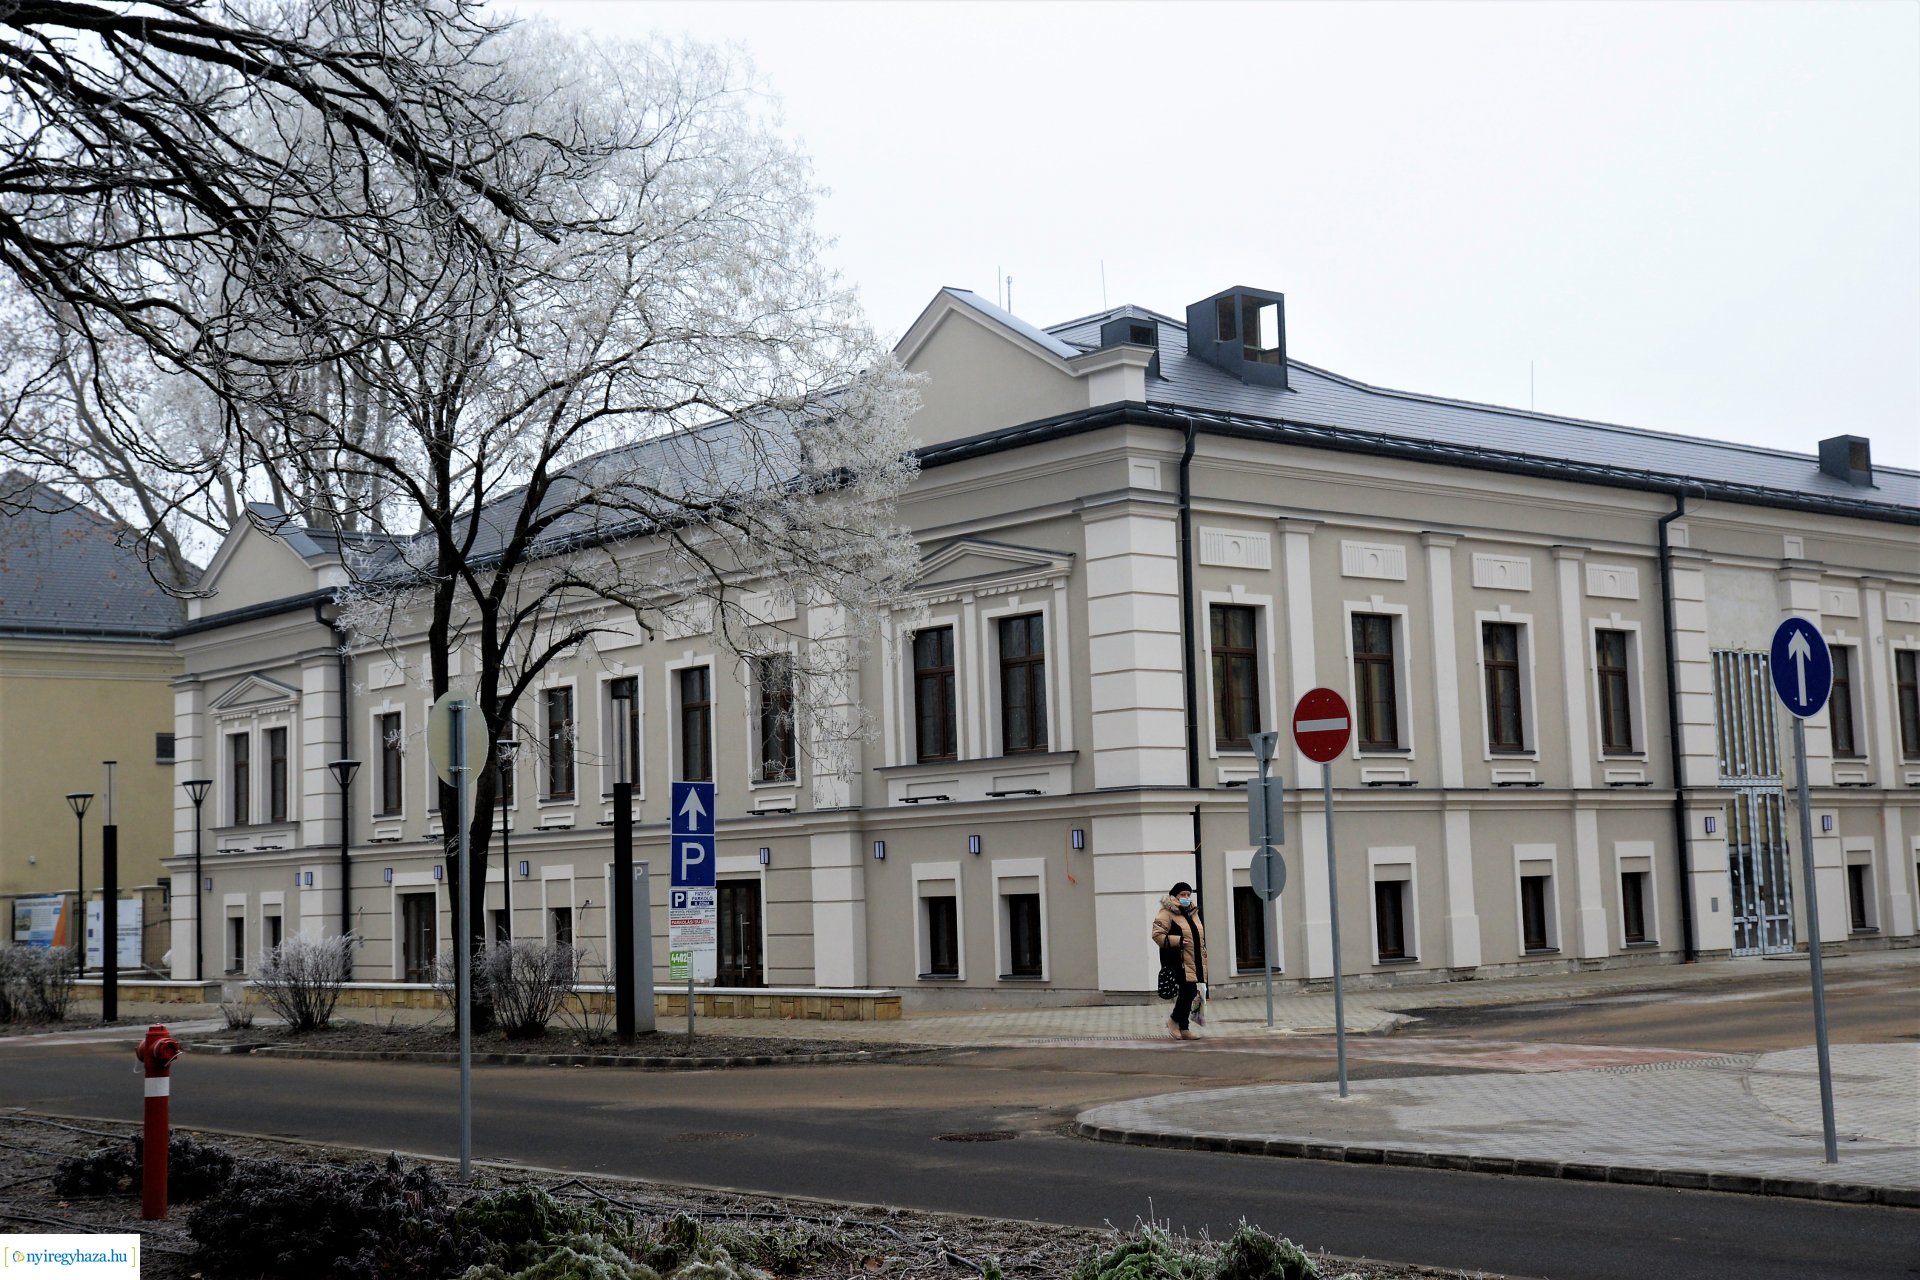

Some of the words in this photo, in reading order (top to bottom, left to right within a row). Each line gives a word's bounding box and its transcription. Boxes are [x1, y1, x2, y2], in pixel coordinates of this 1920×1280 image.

[681, 842, 705, 880] P
[634, 866, 643, 880] P
[675, 893, 685, 907] P
